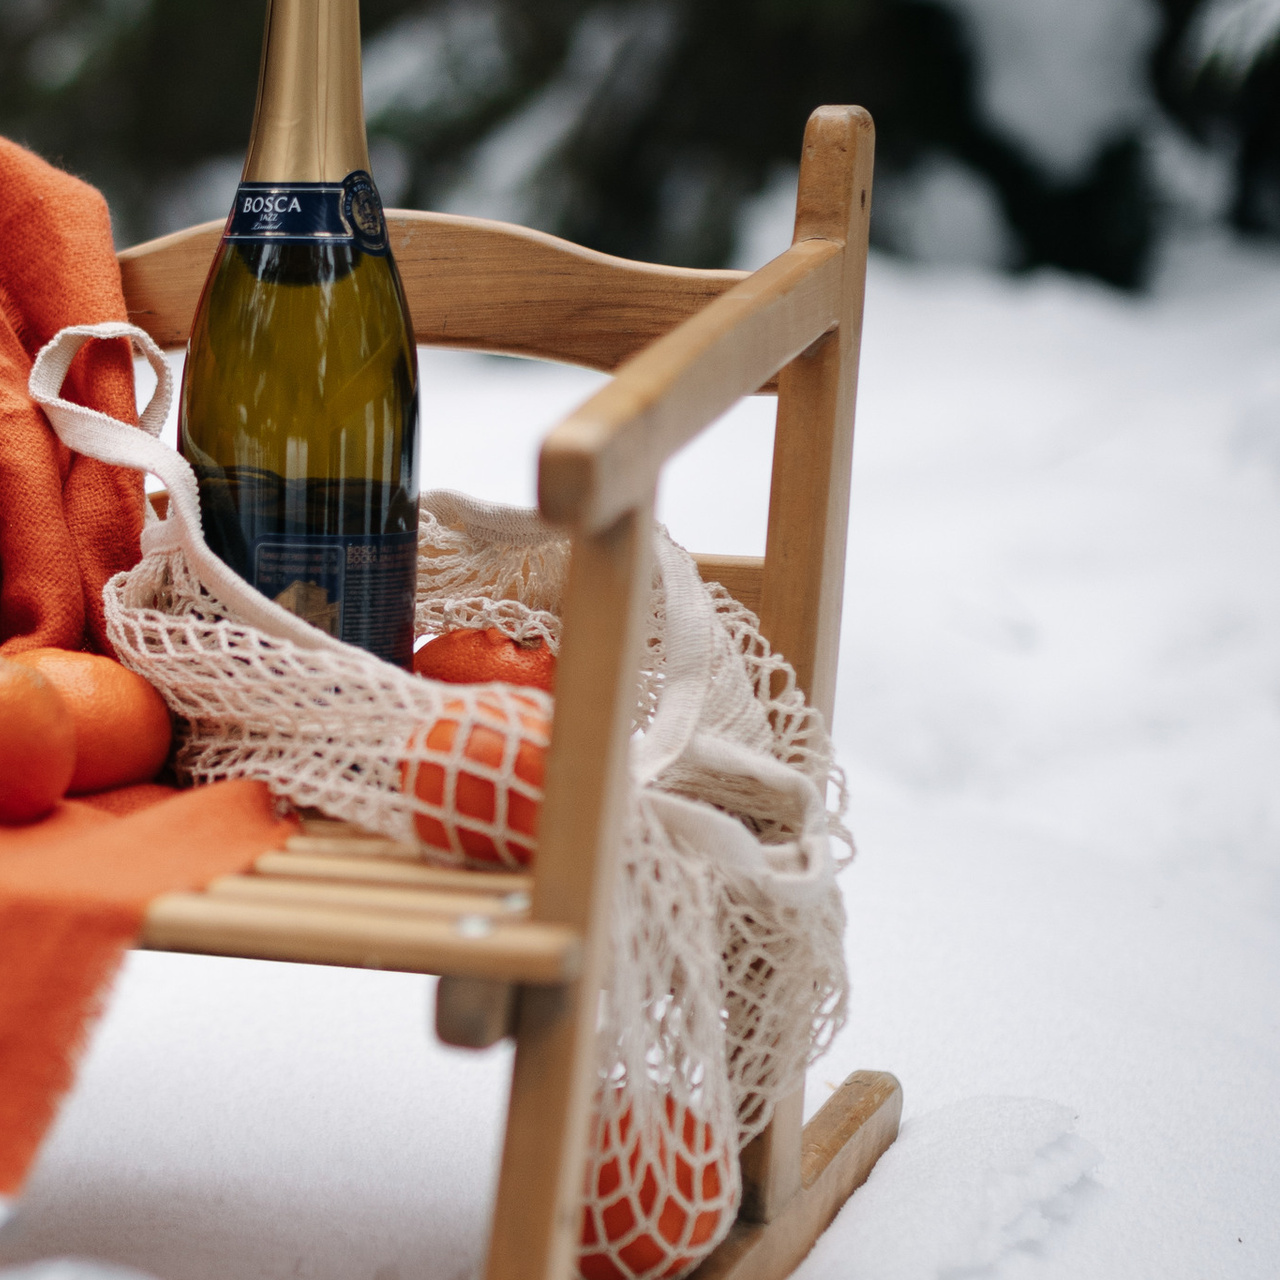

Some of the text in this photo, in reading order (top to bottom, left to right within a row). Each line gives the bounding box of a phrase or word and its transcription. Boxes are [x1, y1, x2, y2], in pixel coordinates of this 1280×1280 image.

[243, 196, 302, 213] BOSCA
[260, 213, 278, 222] JAZZ
[346, 545, 377, 555] BOSCA
